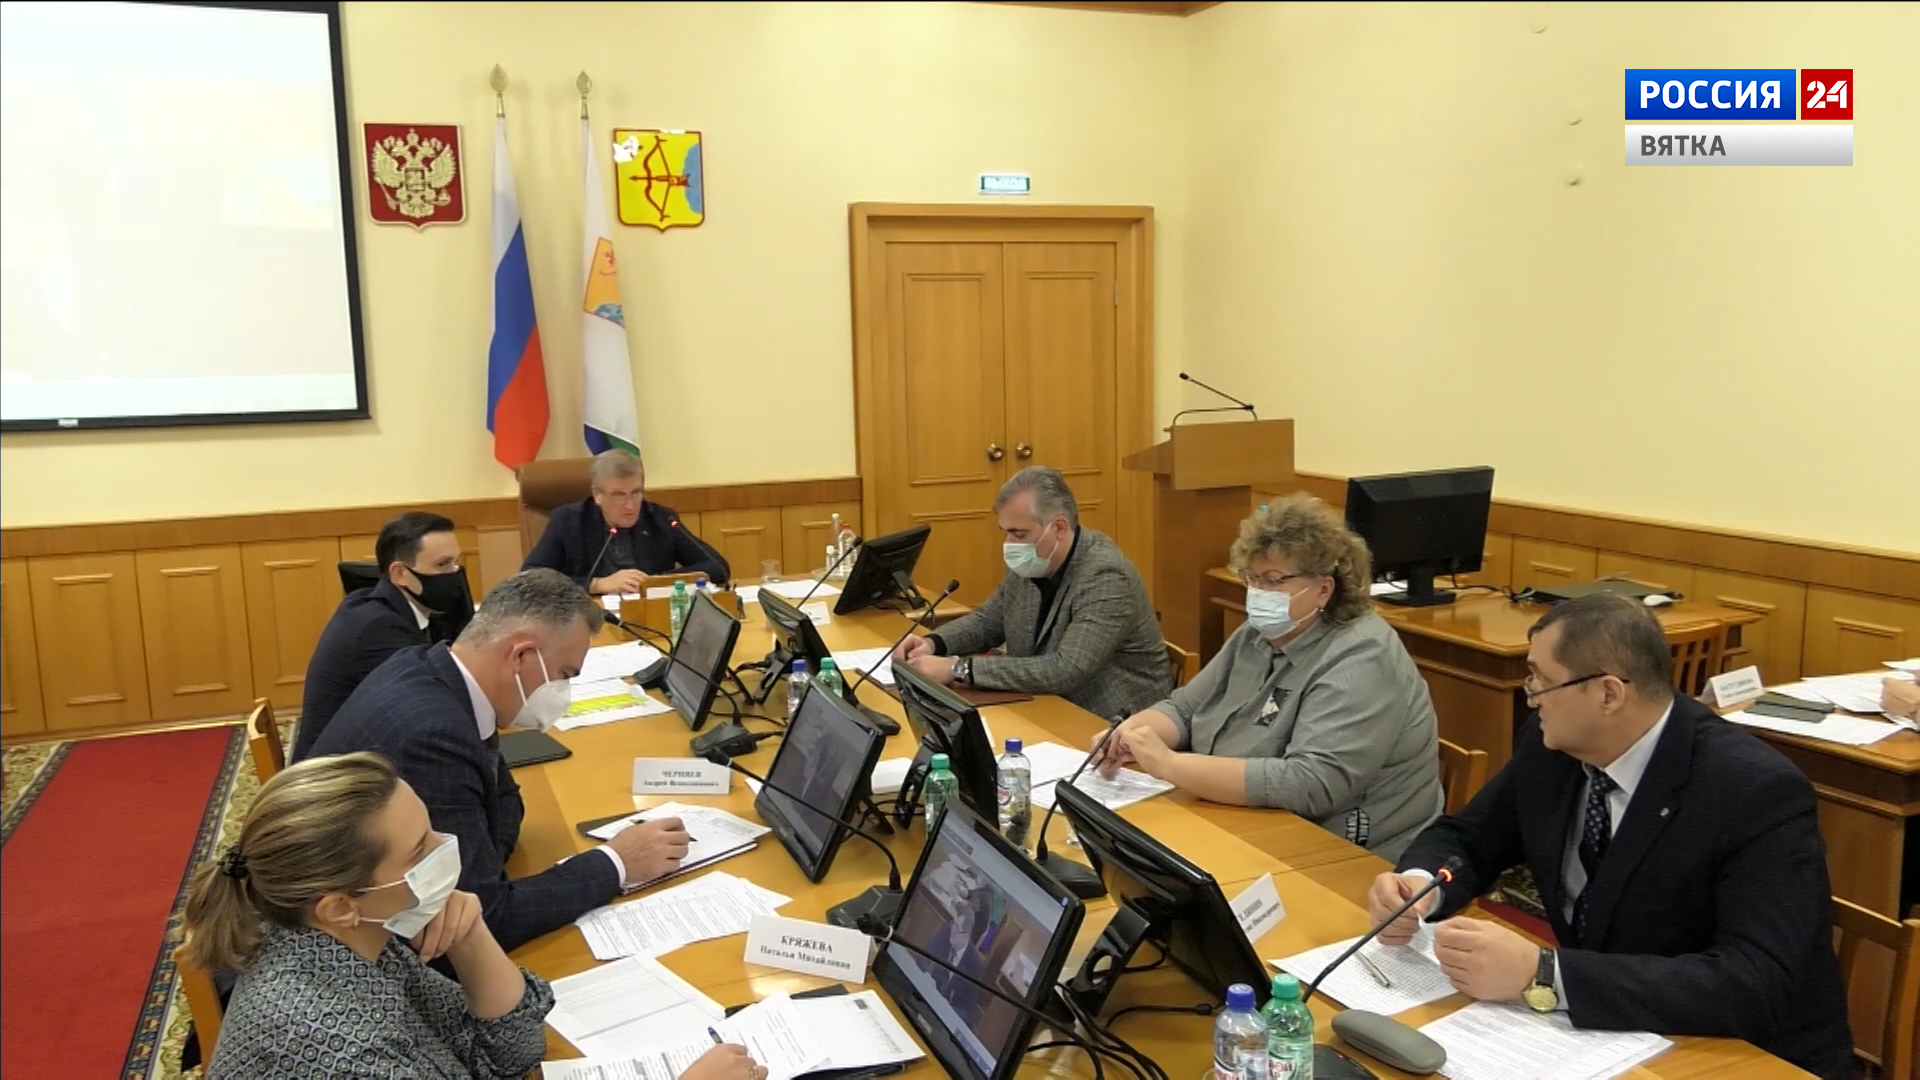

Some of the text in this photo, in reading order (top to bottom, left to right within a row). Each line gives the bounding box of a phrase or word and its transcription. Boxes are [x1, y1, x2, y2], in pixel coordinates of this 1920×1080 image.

[780, 934, 833, 953] КРЯЖЕВА
[760, 944, 851, 970] Наталья Михайловна
